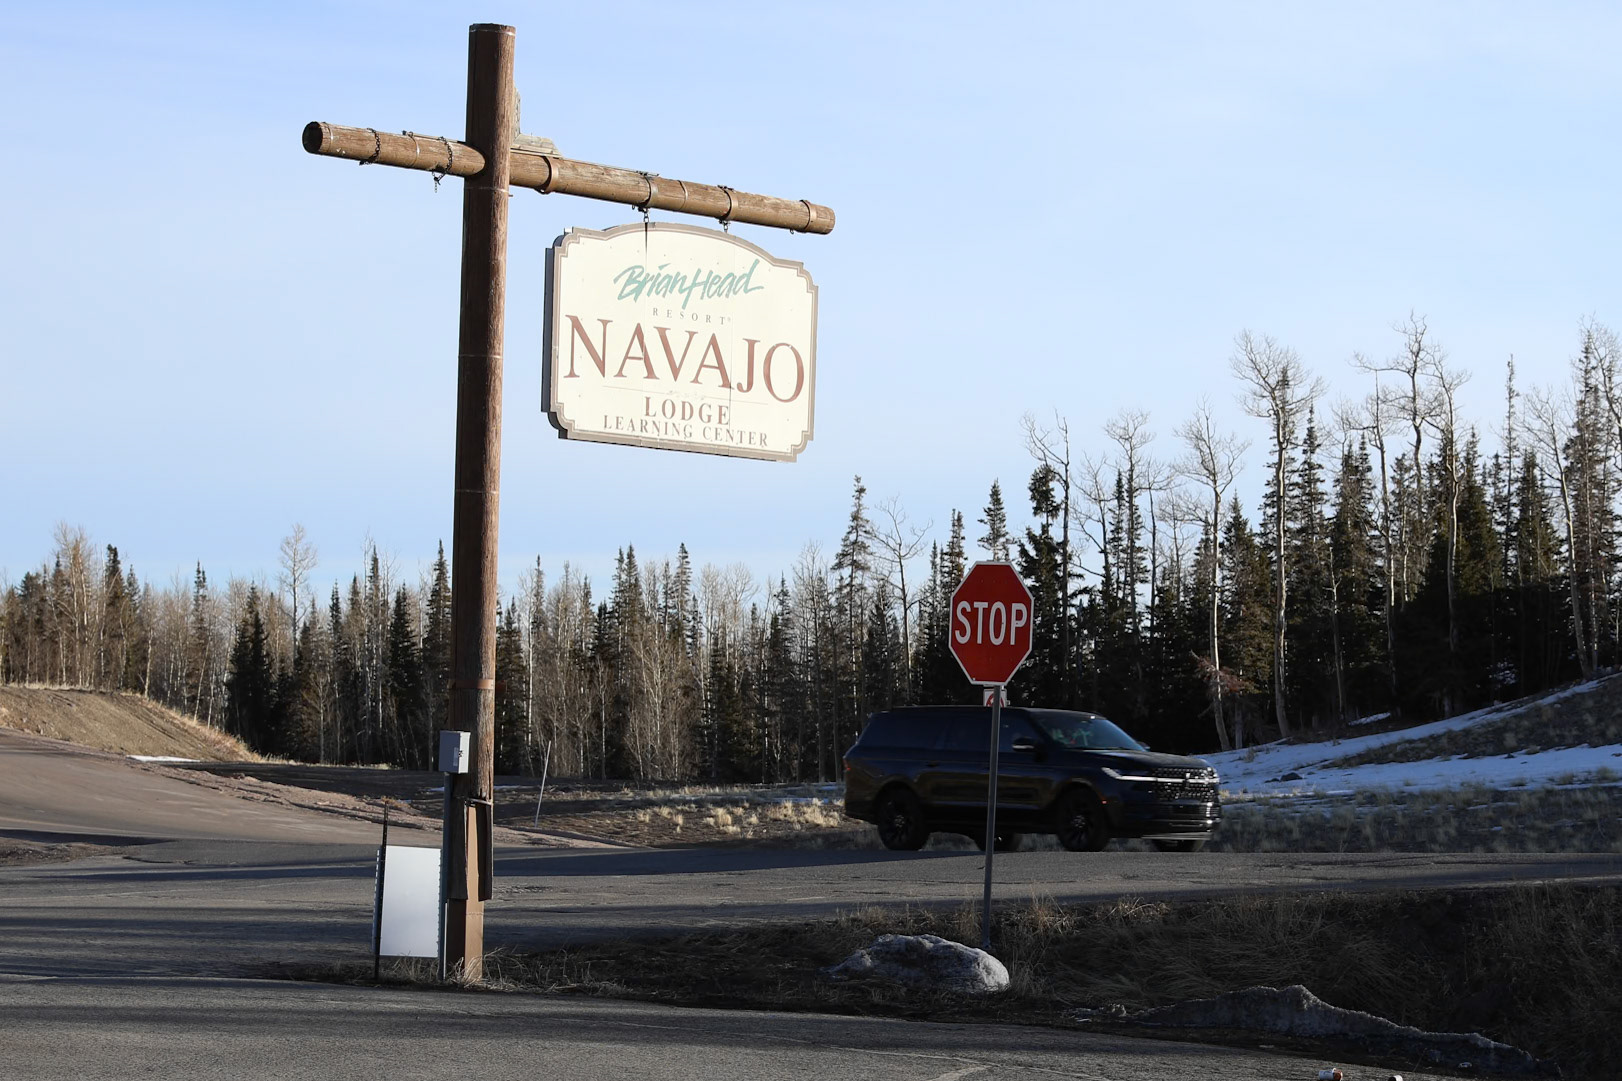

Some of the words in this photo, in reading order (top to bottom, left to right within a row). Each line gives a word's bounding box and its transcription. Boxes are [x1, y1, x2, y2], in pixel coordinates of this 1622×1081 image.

[613, 263, 688, 303] Brian
[681, 258, 765, 310] Head
[563, 314, 805, 403] NAVAJO
[603, 415, 693, 438] LEARNING
[702, 425, 768, 447] CENTER
[644, 396, 730, 425] LODGE
[955, 600, 1028, 646] STOP
